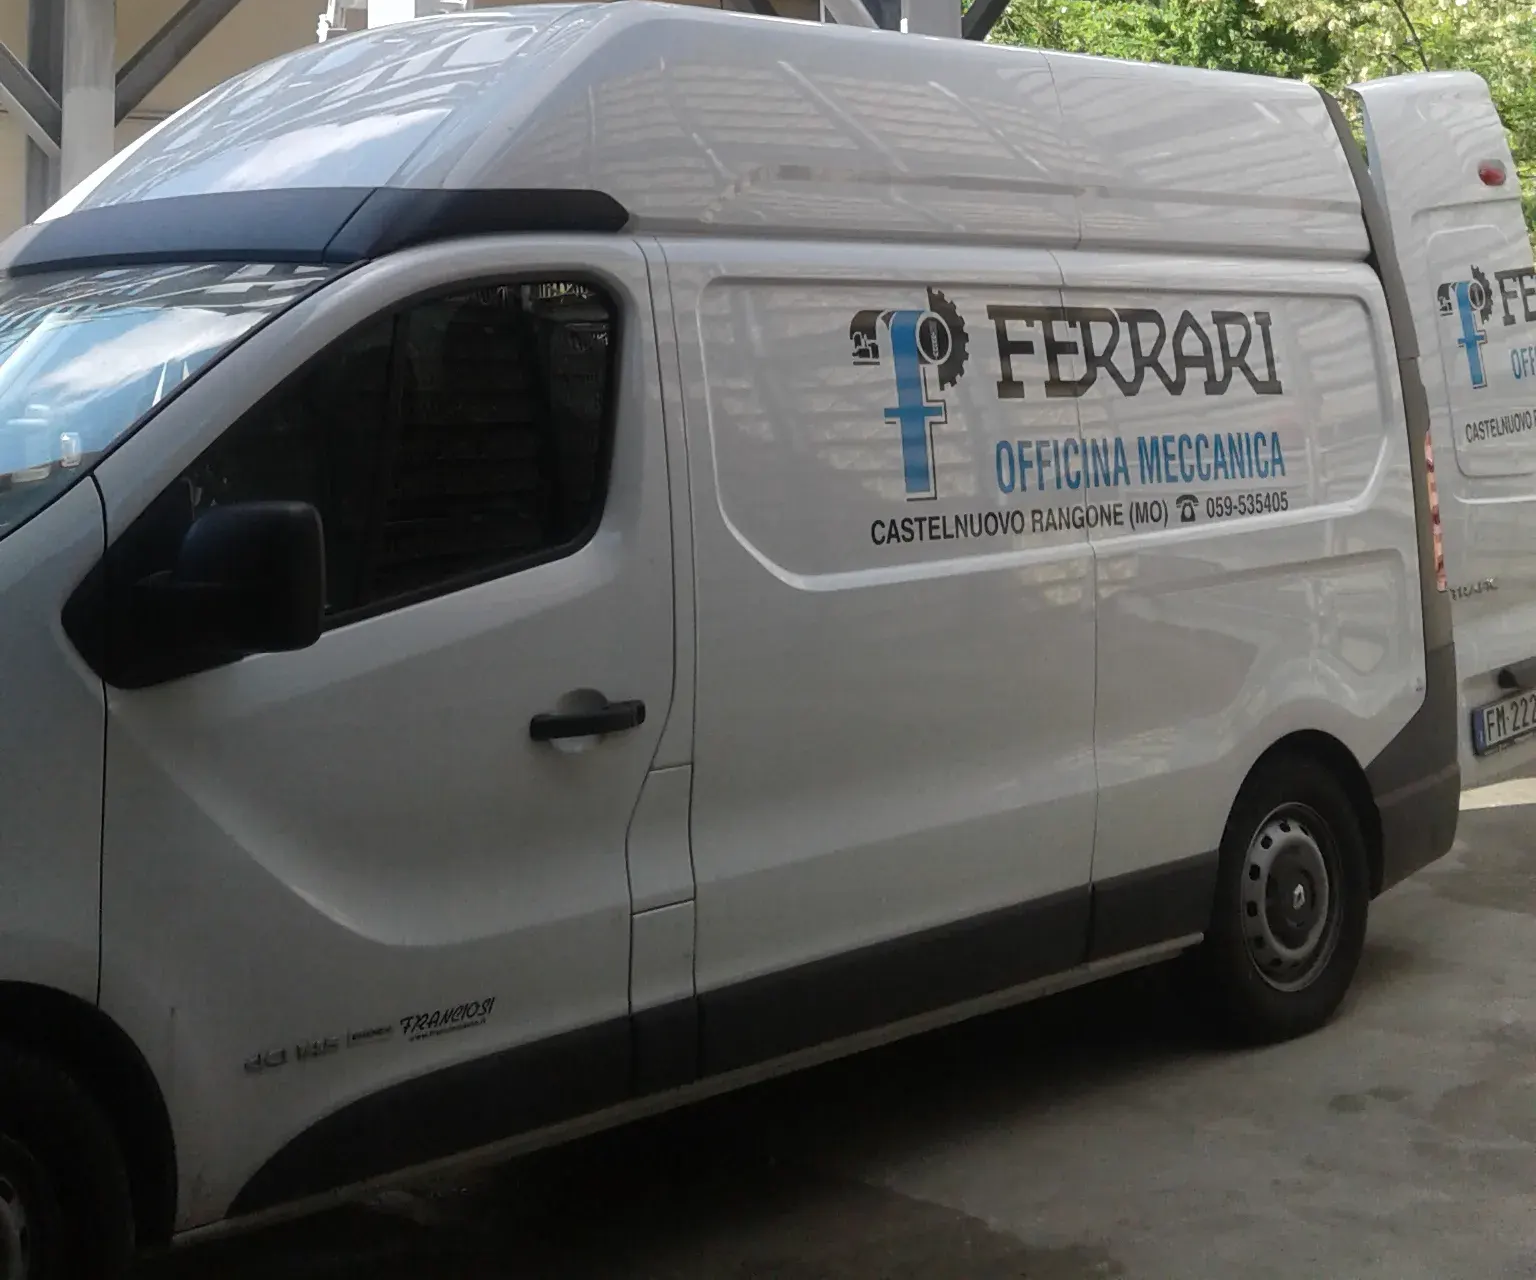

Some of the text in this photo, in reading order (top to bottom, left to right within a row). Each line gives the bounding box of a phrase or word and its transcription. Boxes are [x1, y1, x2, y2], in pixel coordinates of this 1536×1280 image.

[986, 304, 1283, 399] FERRARI
[1510, 345, 1536, 380] OFF
[1465, 409, 1533, 444] CASTELNUOVO
[995, 430, 1287, 495] OFFICINA MECCANICA
[870, 491, 1289, 546] CASTELNUOVO RANGONE (MO) 059-535405
[400, 996, 496, 1035] FRANCIOSI
